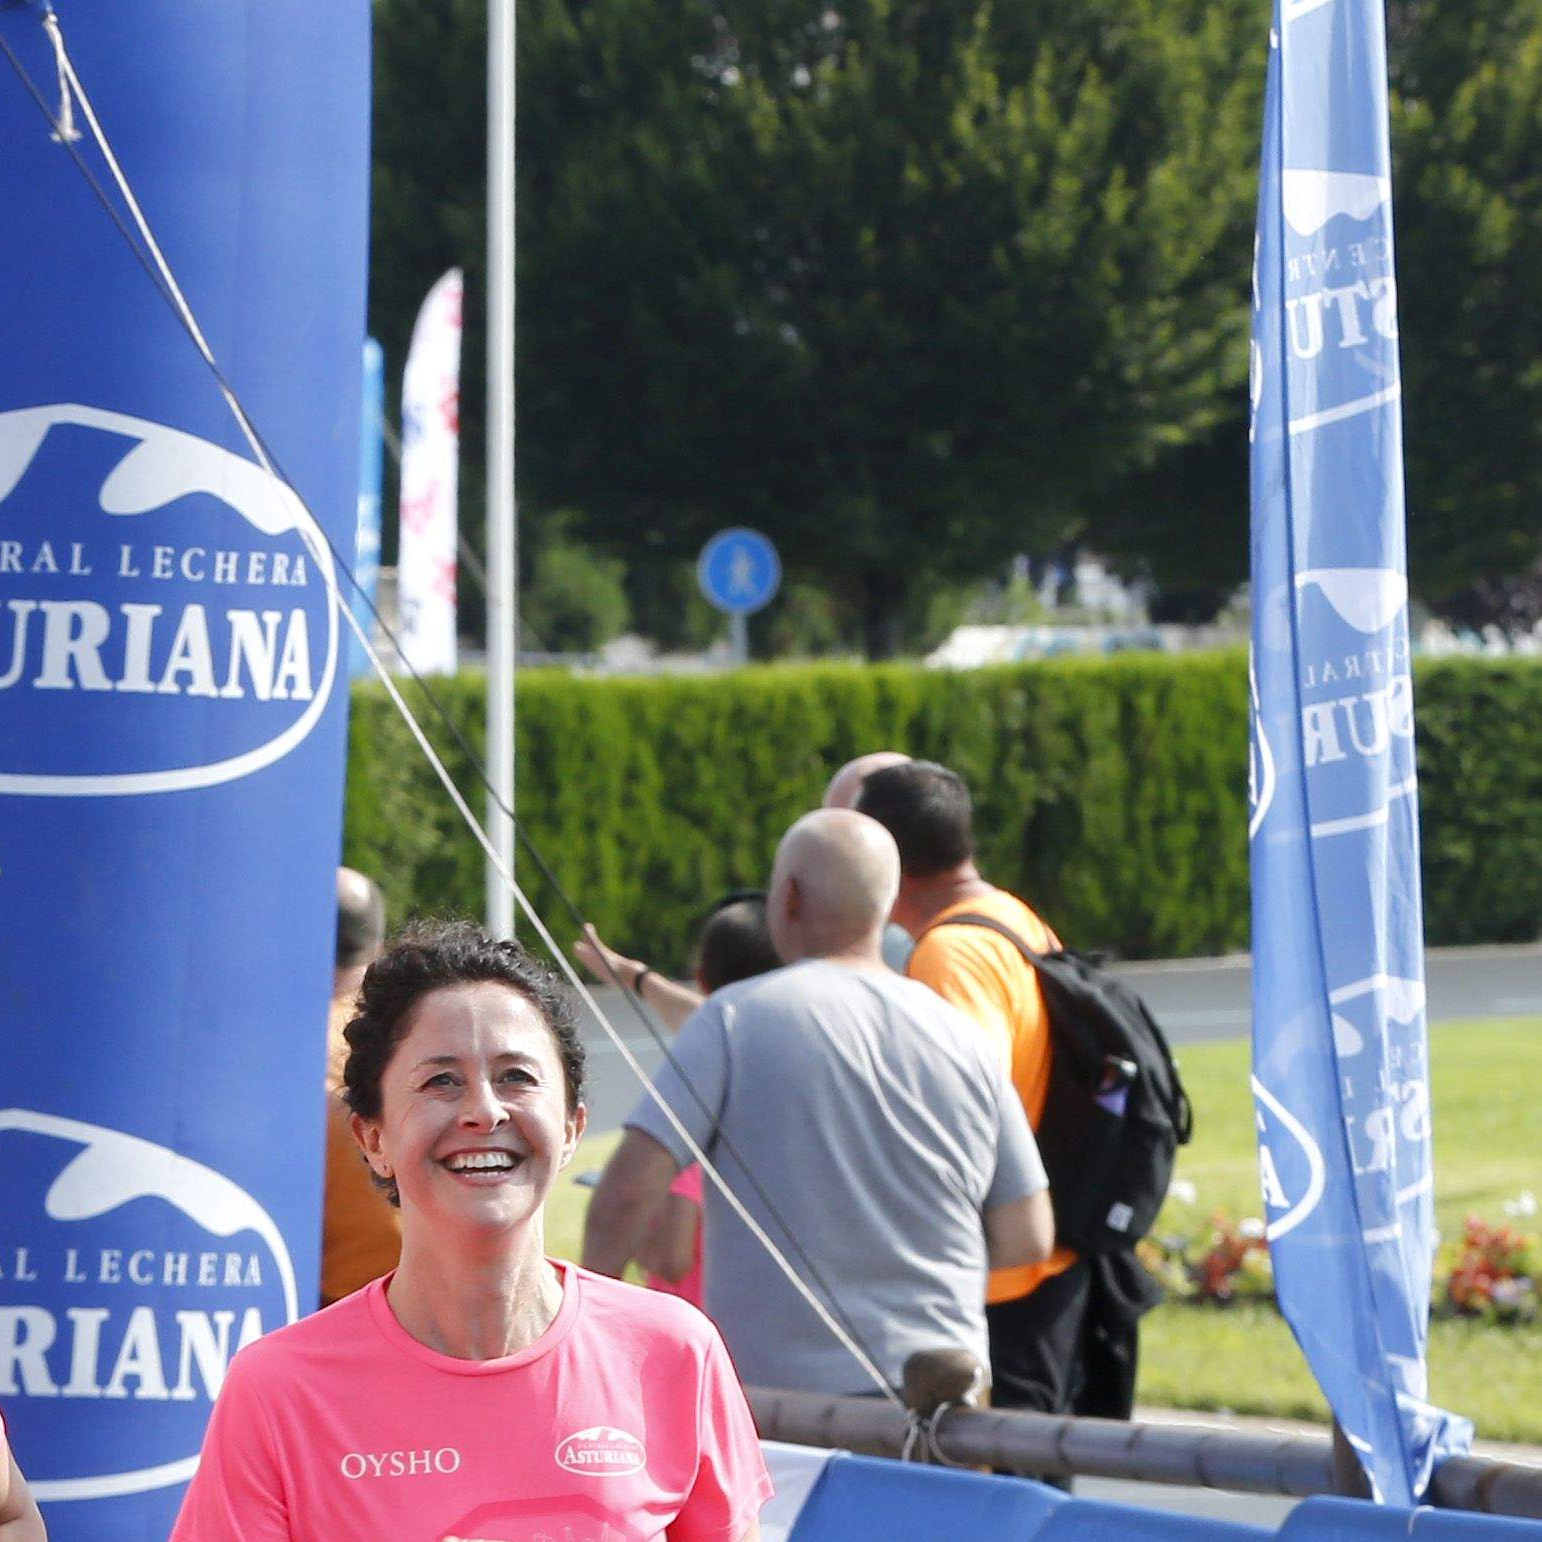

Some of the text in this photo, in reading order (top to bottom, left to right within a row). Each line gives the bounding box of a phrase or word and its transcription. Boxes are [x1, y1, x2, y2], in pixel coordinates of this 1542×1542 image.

[118, 542, 308, 589] LECHERA
[66, 1249, 262, 1287] LECHERA
[341, 1446, 461, 1479] OYSHO
